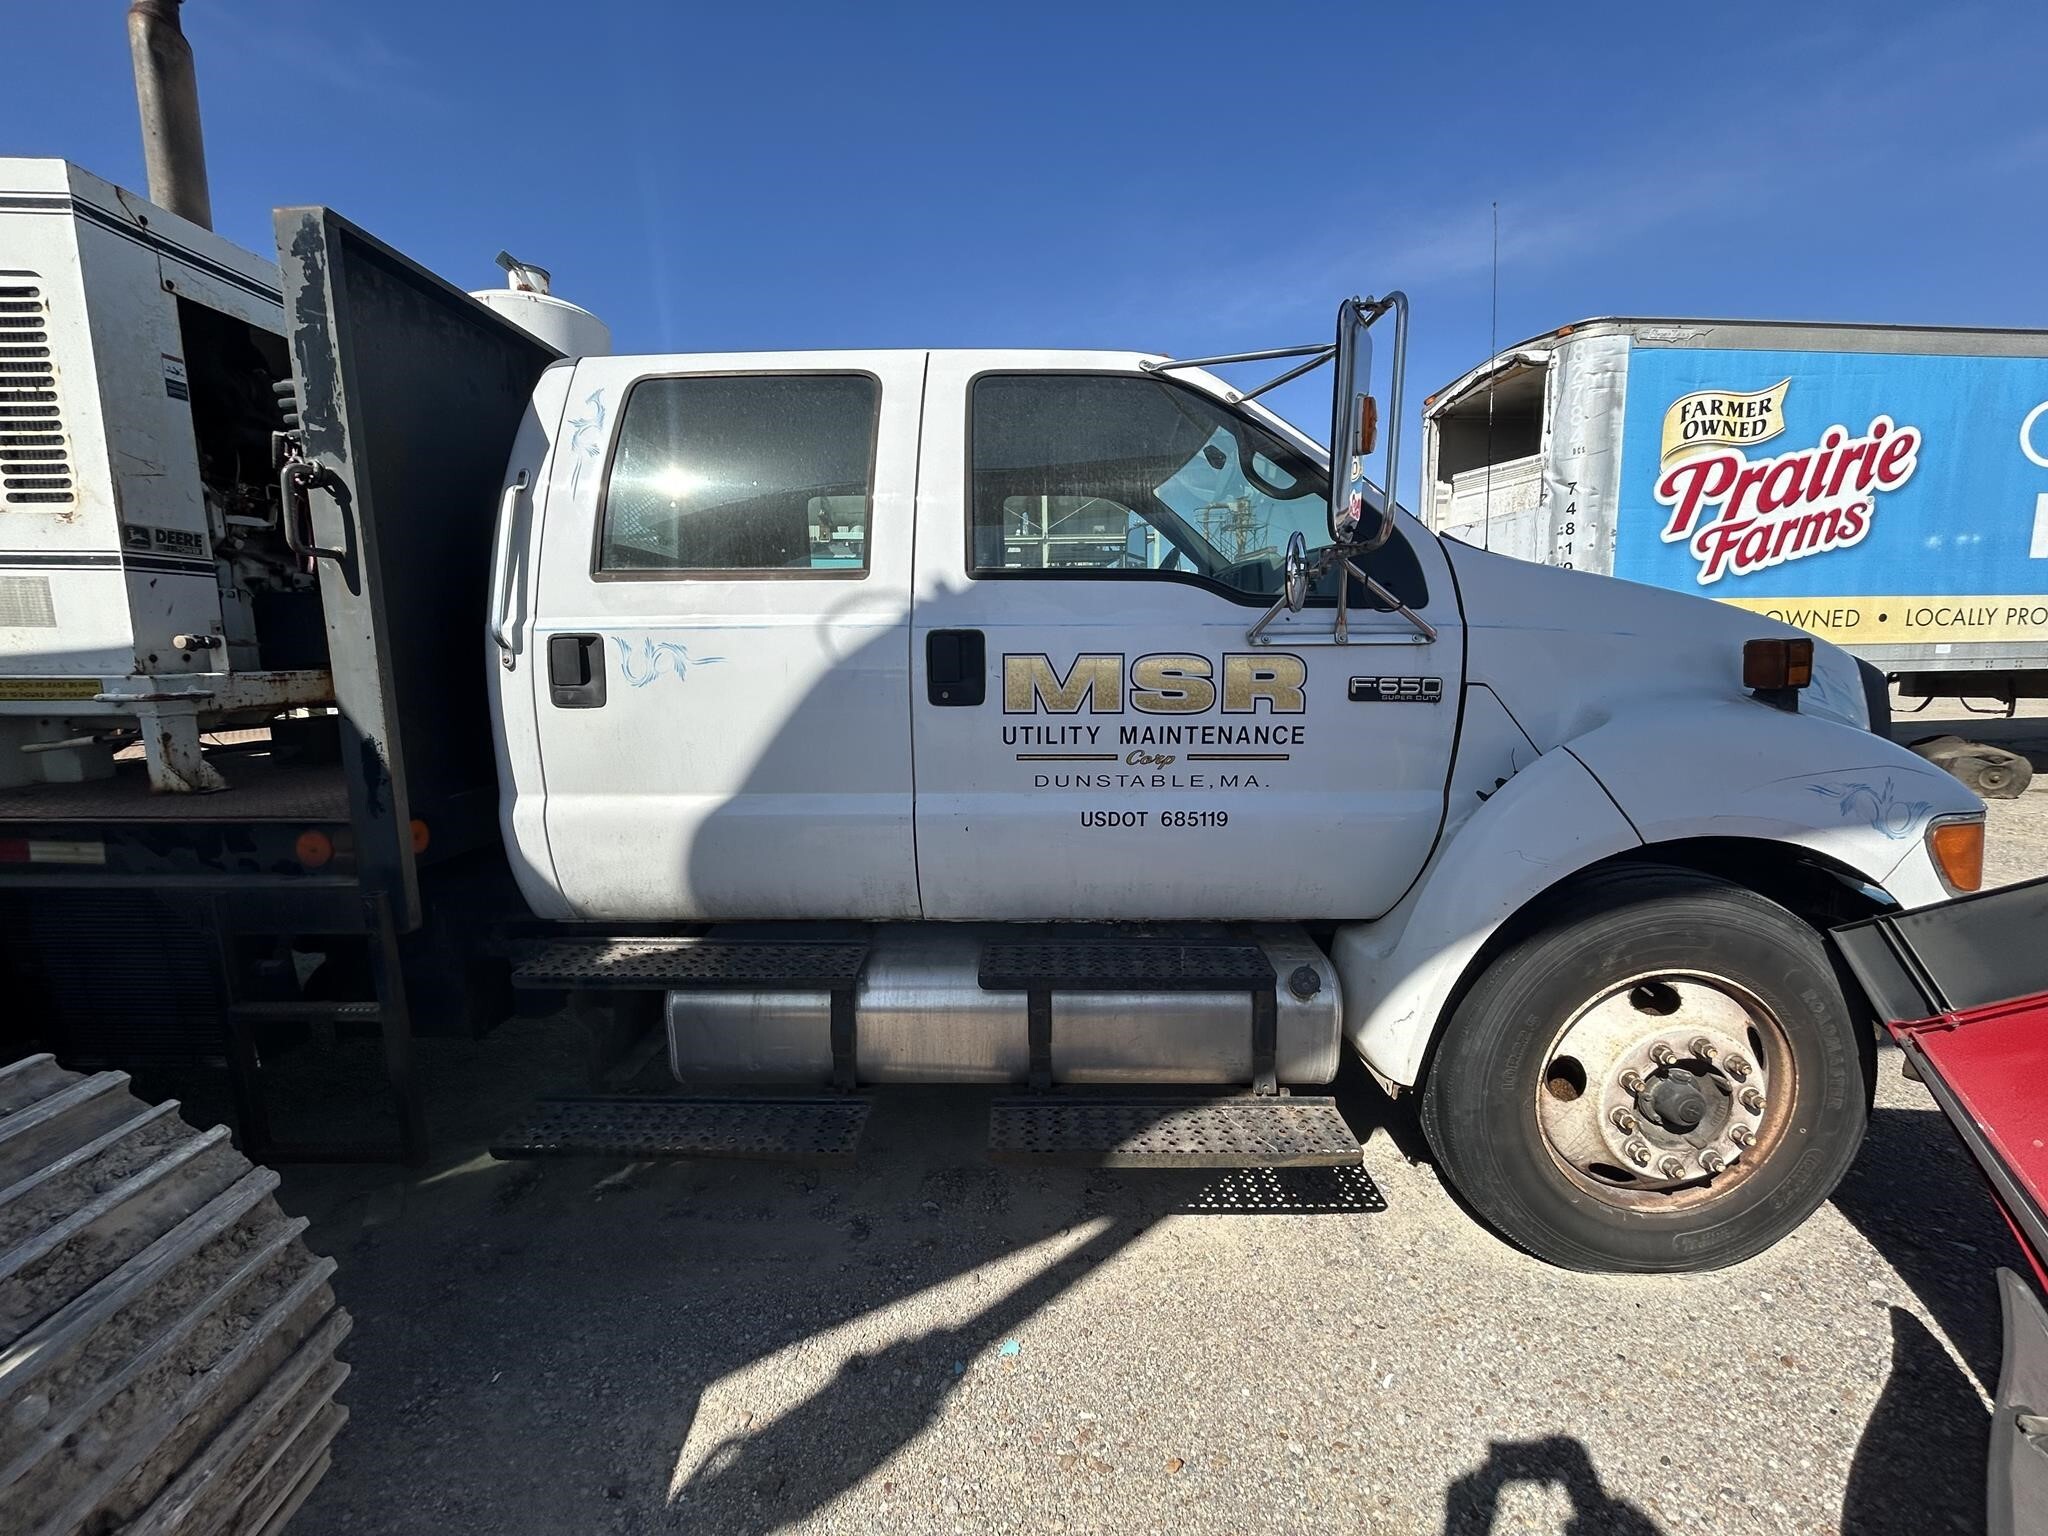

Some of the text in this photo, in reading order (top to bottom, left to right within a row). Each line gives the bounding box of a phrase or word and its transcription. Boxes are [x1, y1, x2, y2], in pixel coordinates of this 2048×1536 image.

[1680, 398, 1772, 424] FARMER
[1682, 418, 1767, 440] OWNED
[1660, 422, 1914, 535] Prairie
[155, 528, 202, 547] DEERE
[1697, 501, 1868, 577] Farms
[1905, 608, 1998, 627] LOCALLY
[1002, 653, 1308, 715] MSR
[1002, 726, 1305, 745] UTILITY MAINTENANCE
[1125, 749, 1176, 770] Corp
[1081, 811, 1229, 827] USDOT 685119
